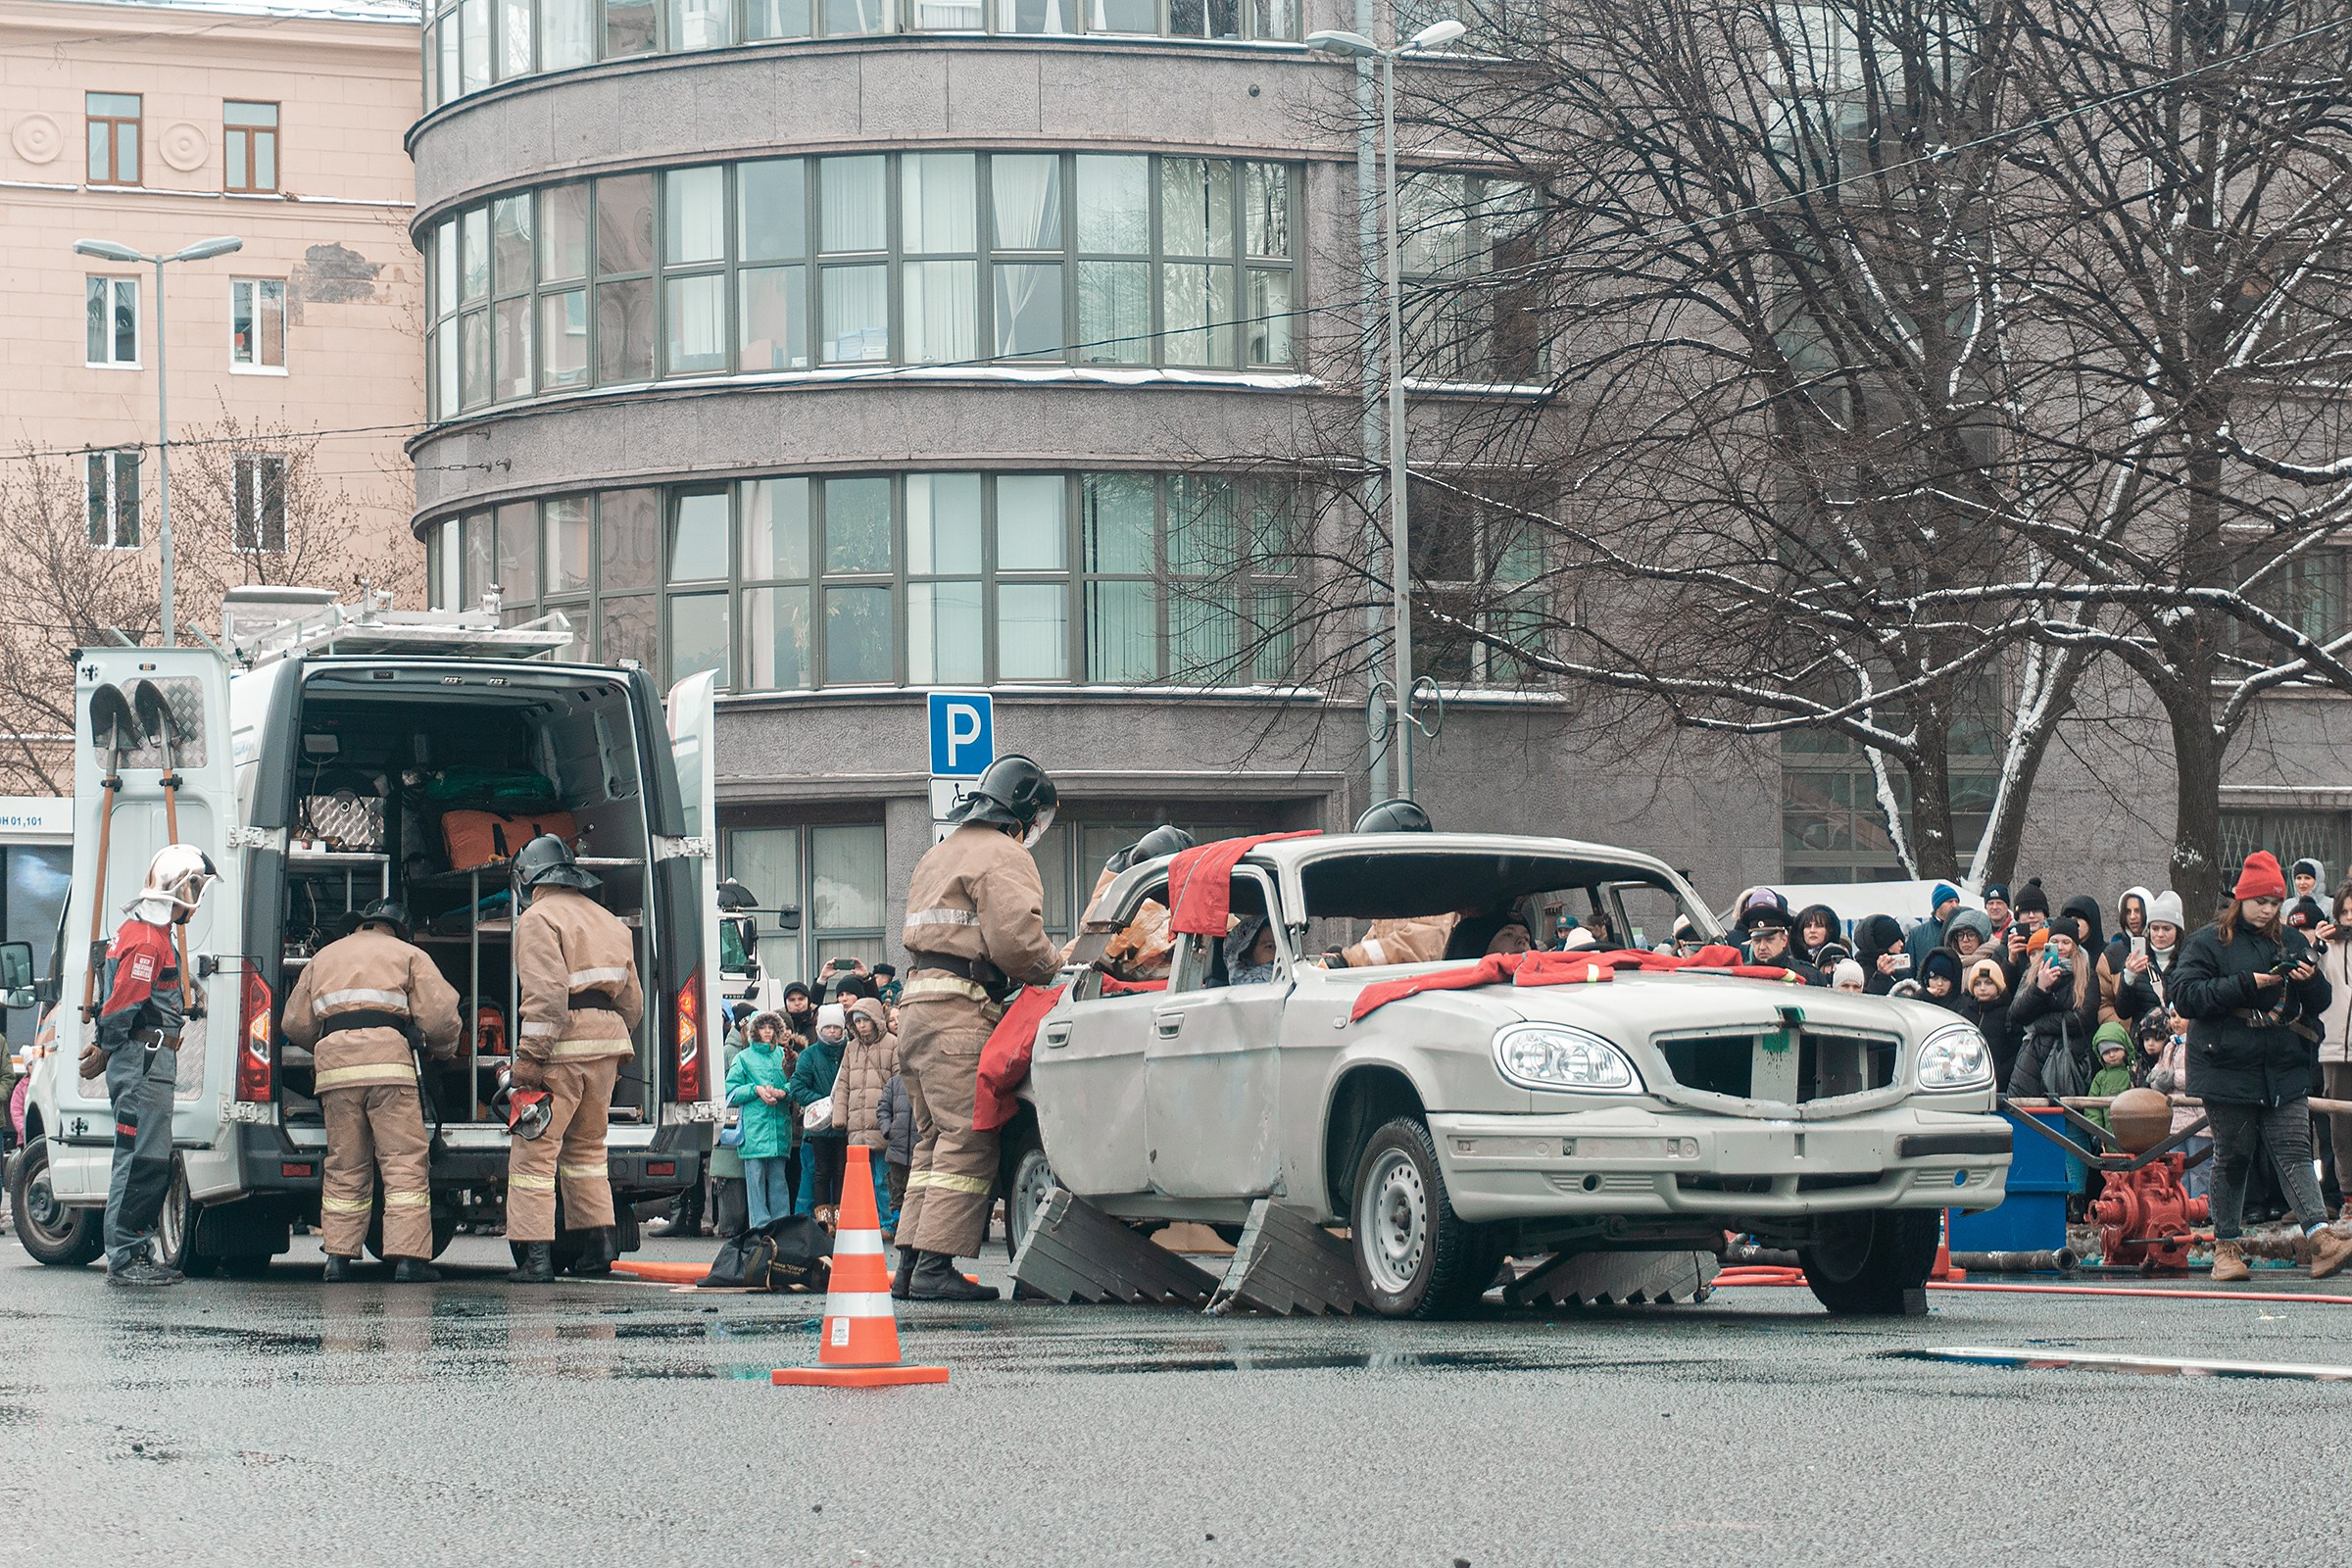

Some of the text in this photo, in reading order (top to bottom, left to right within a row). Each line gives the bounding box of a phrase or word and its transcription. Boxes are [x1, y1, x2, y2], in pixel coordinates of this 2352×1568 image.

[947, 704, 982, 767] P
[0, 815, 42, 828] Н 01,101
